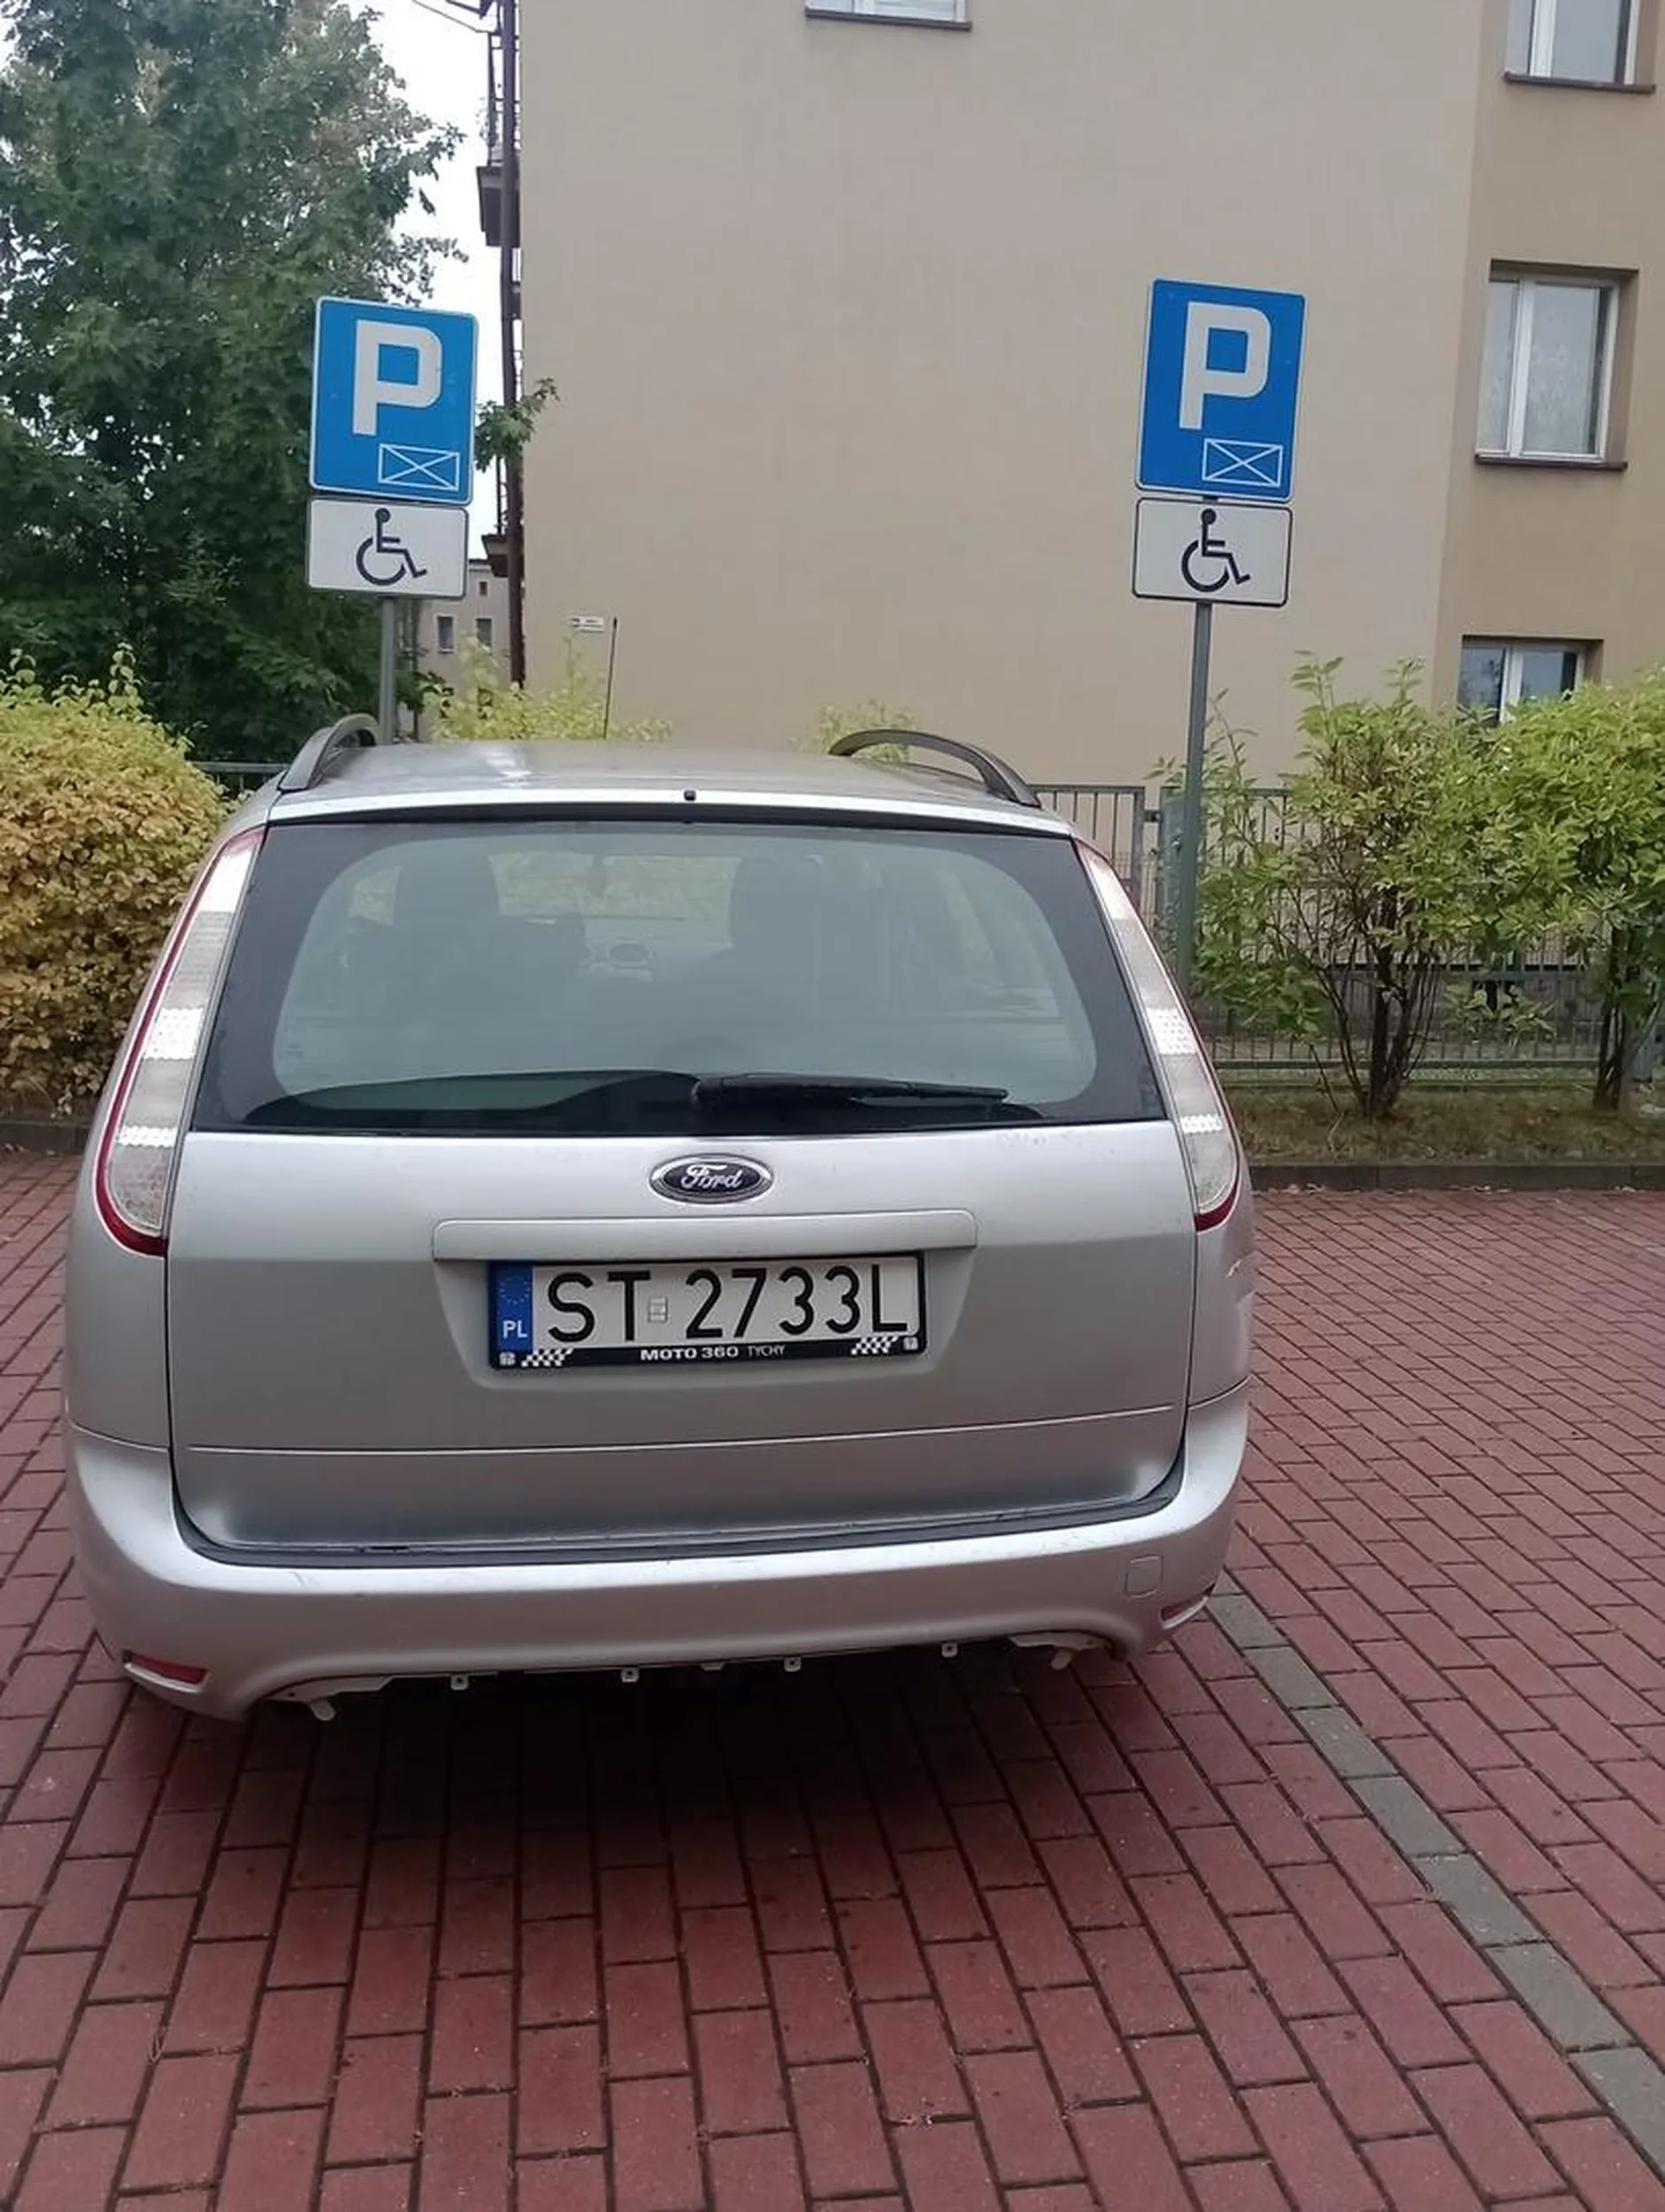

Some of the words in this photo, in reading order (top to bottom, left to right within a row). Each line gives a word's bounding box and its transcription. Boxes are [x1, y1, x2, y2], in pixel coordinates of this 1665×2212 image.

[352, 319, 442, 436] P
[1178, 301, 1272, 430] P
[680, 1164, 743, 1189] Ford
[548, 1271, 651, 1342] ST
[685, 1263, 908, 1340] 2733L
[502, 1319, 528, 1339] PL
[640, 1347, 697, 1361] MOTO
[702, 1346, 739, 1359] 360
[747, 1344, 786, 1357] TYCHY
